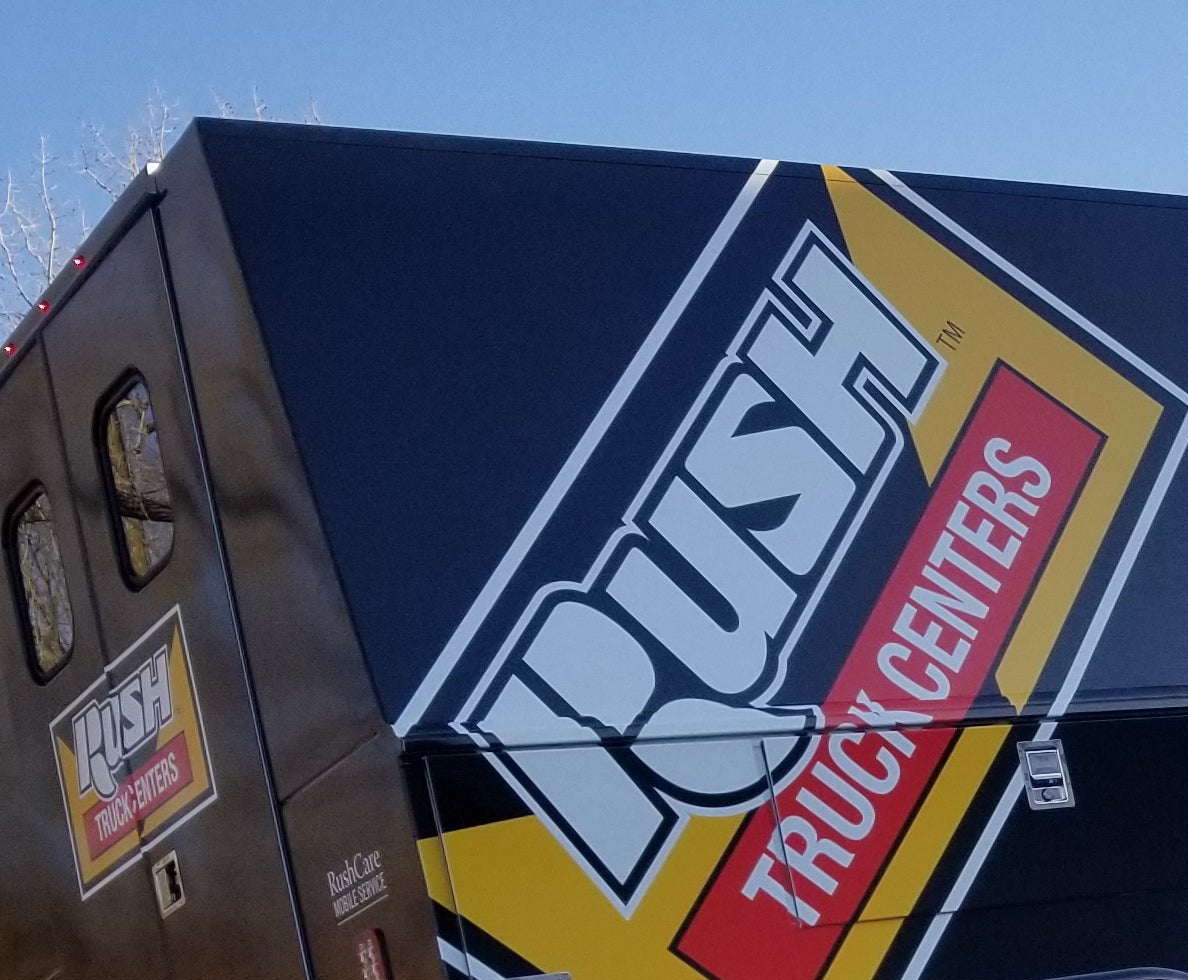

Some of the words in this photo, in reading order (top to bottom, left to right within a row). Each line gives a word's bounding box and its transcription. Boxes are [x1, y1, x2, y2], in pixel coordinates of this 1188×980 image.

[936, 320, 965, 351] TM
[741, 688, 934, 927] TRUCK
[877, 436, 1053, 710] CENTERS
[95, 796, 130, 841] TRUCK
[326, 850, 382, 896] RushCare
[357, 872, 387, 903] SERVICE
